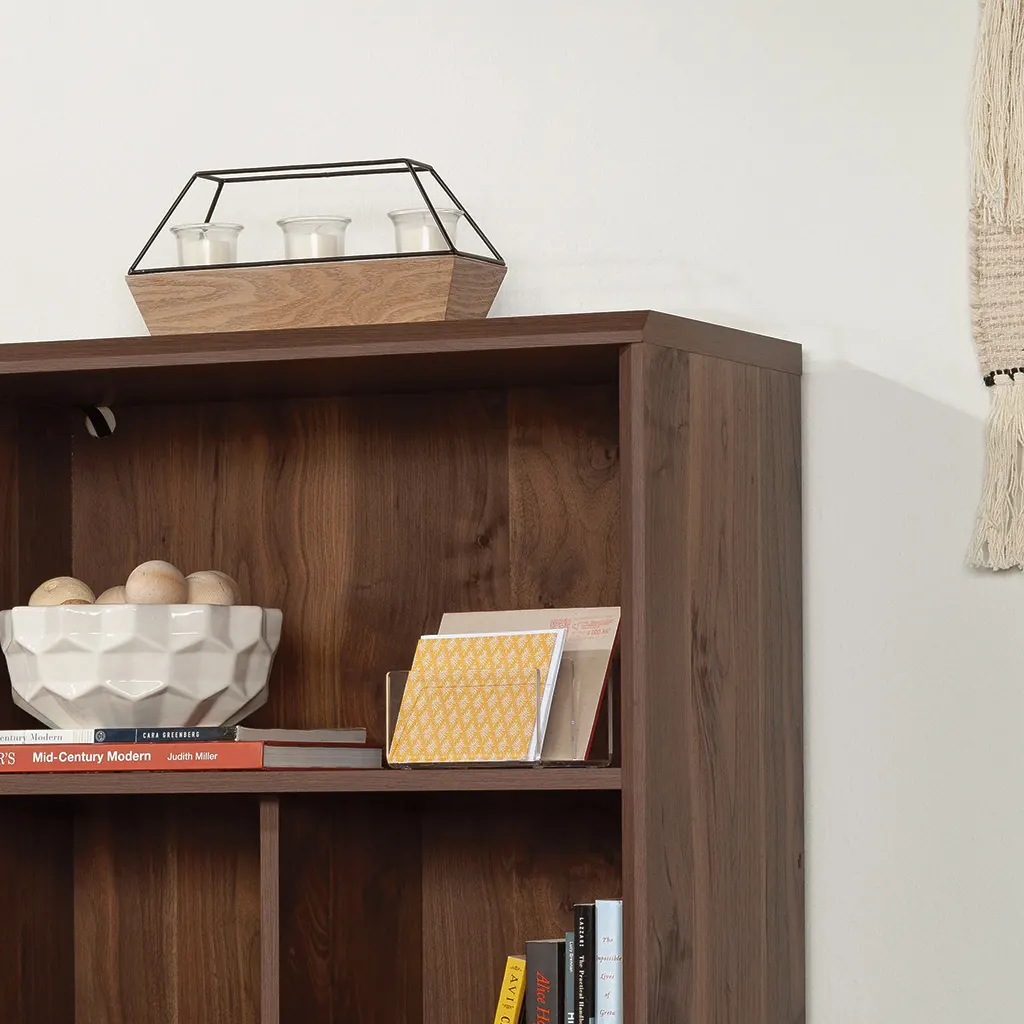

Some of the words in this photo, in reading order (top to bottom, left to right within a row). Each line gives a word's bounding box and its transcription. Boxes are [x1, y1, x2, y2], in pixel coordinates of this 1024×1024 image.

[30, 733, 63, 741] Modern
[163, 731, 200, 739] GREENBERG
[33, 751, 104, 764] Mid-Century
[107, 751, 151, 762] Modern
[195, 752, 218, 760] Miller
[506, 974, 518, 1002] AVI
[536, 970, 550, 1004] Alice
